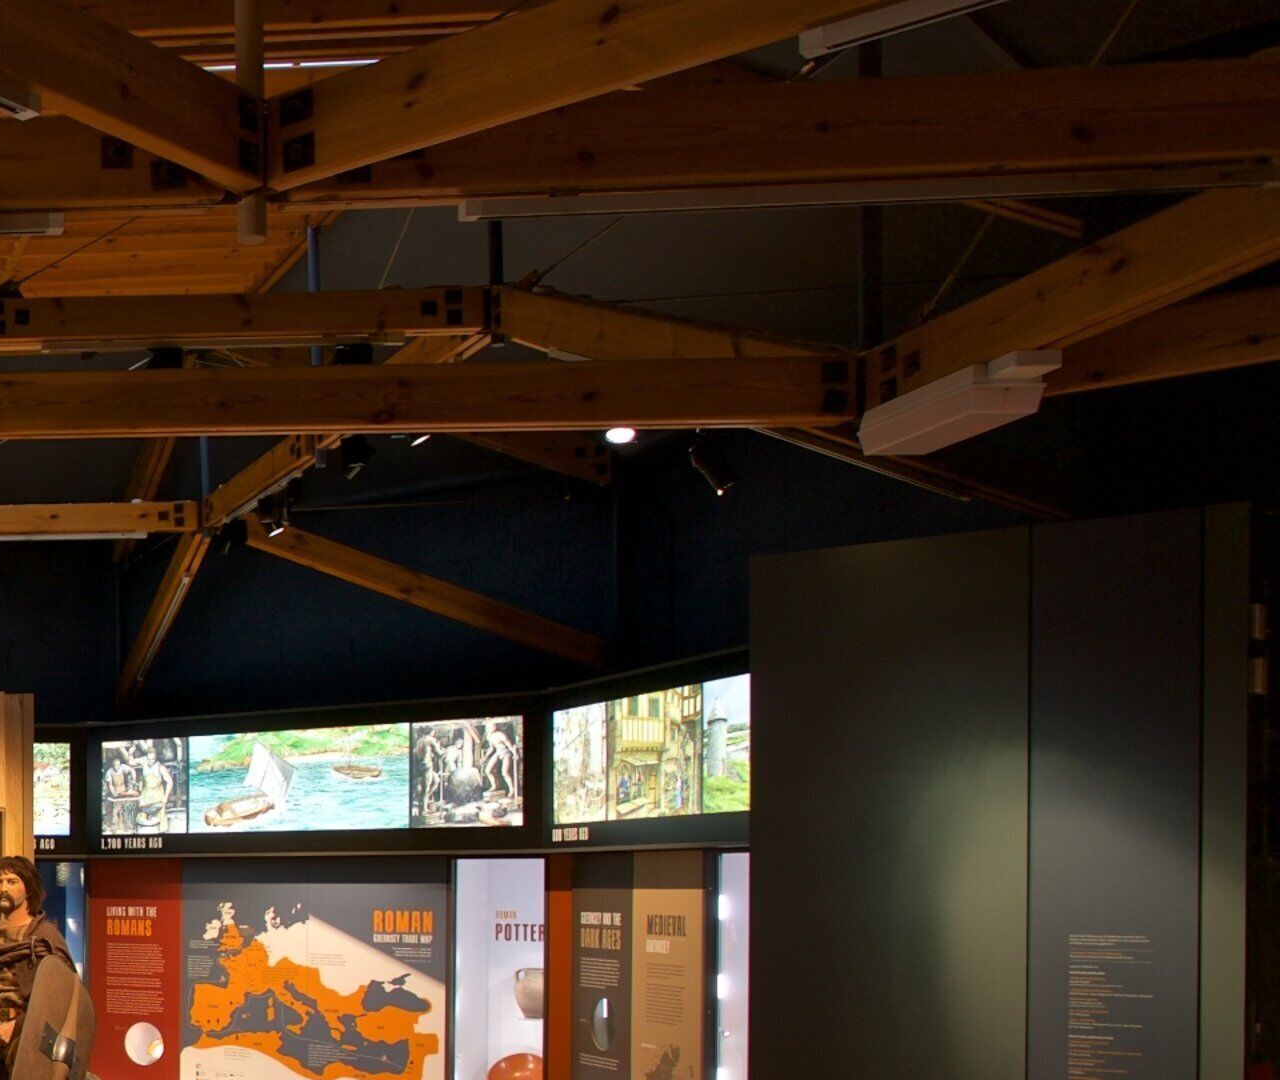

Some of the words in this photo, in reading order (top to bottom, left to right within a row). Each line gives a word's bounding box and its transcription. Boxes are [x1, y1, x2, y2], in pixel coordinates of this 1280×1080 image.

[40, 838, 55, 850] AGO
[101, 838, 122, 850] 1,700
[124, 837, 146, 849] YEARS
[148, 837, 162, 849] AGO
[106, 906, 126, 917] LIVING
[127, 906, 144, 917] WITH
[145, 906, 157, 917] THE
[495, 910, 517, 919] ROMAN
[106, 920, 152, 937] ROMANS
[373, 910, 433, 933] ROMAN
[646, 914, 687, 937] MEDIEVAL
[402, 934, 418, 943] TRADE
[495, 923, 544, 942] POTTER
[601, 928, 622, 950] AGES
